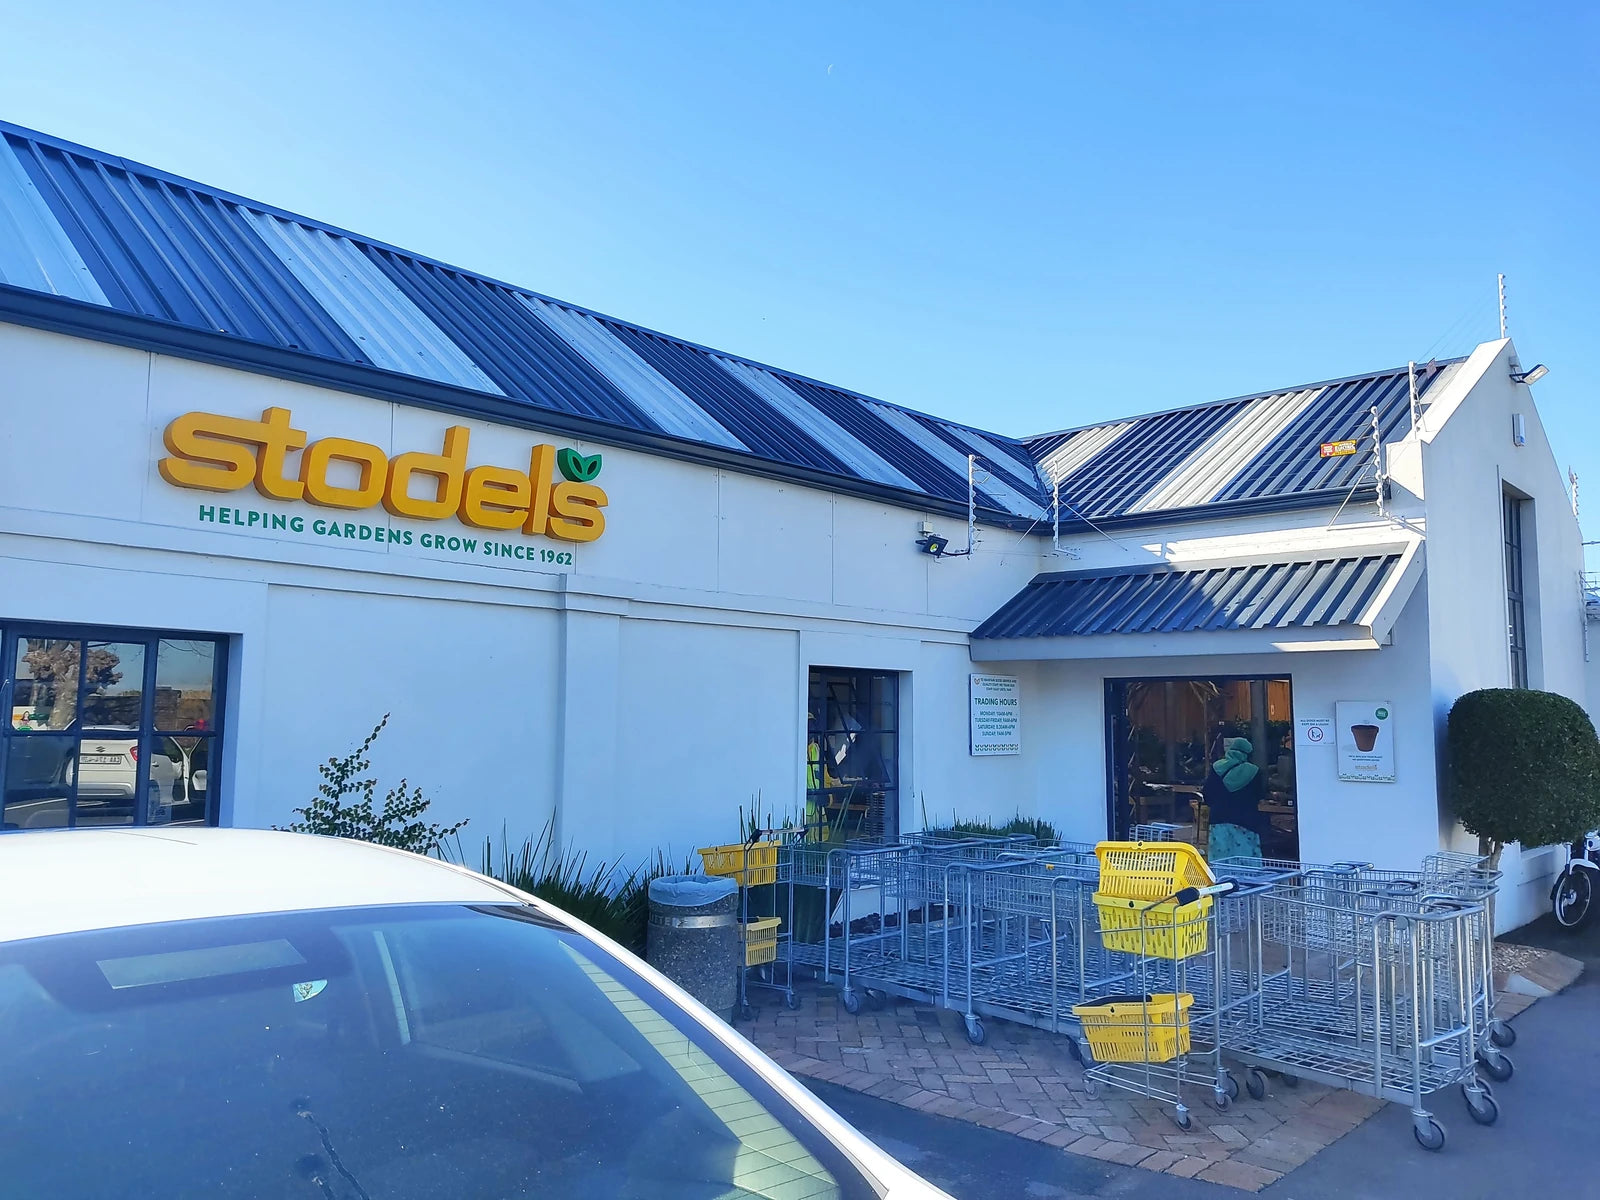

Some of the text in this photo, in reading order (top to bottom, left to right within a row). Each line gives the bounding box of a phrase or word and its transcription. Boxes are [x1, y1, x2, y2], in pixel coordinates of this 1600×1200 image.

[199, 504, 573, 566] HELPING GARDENS GROW SINCE 1962
[974, 697, 1018, 706] TRADING HOURS
